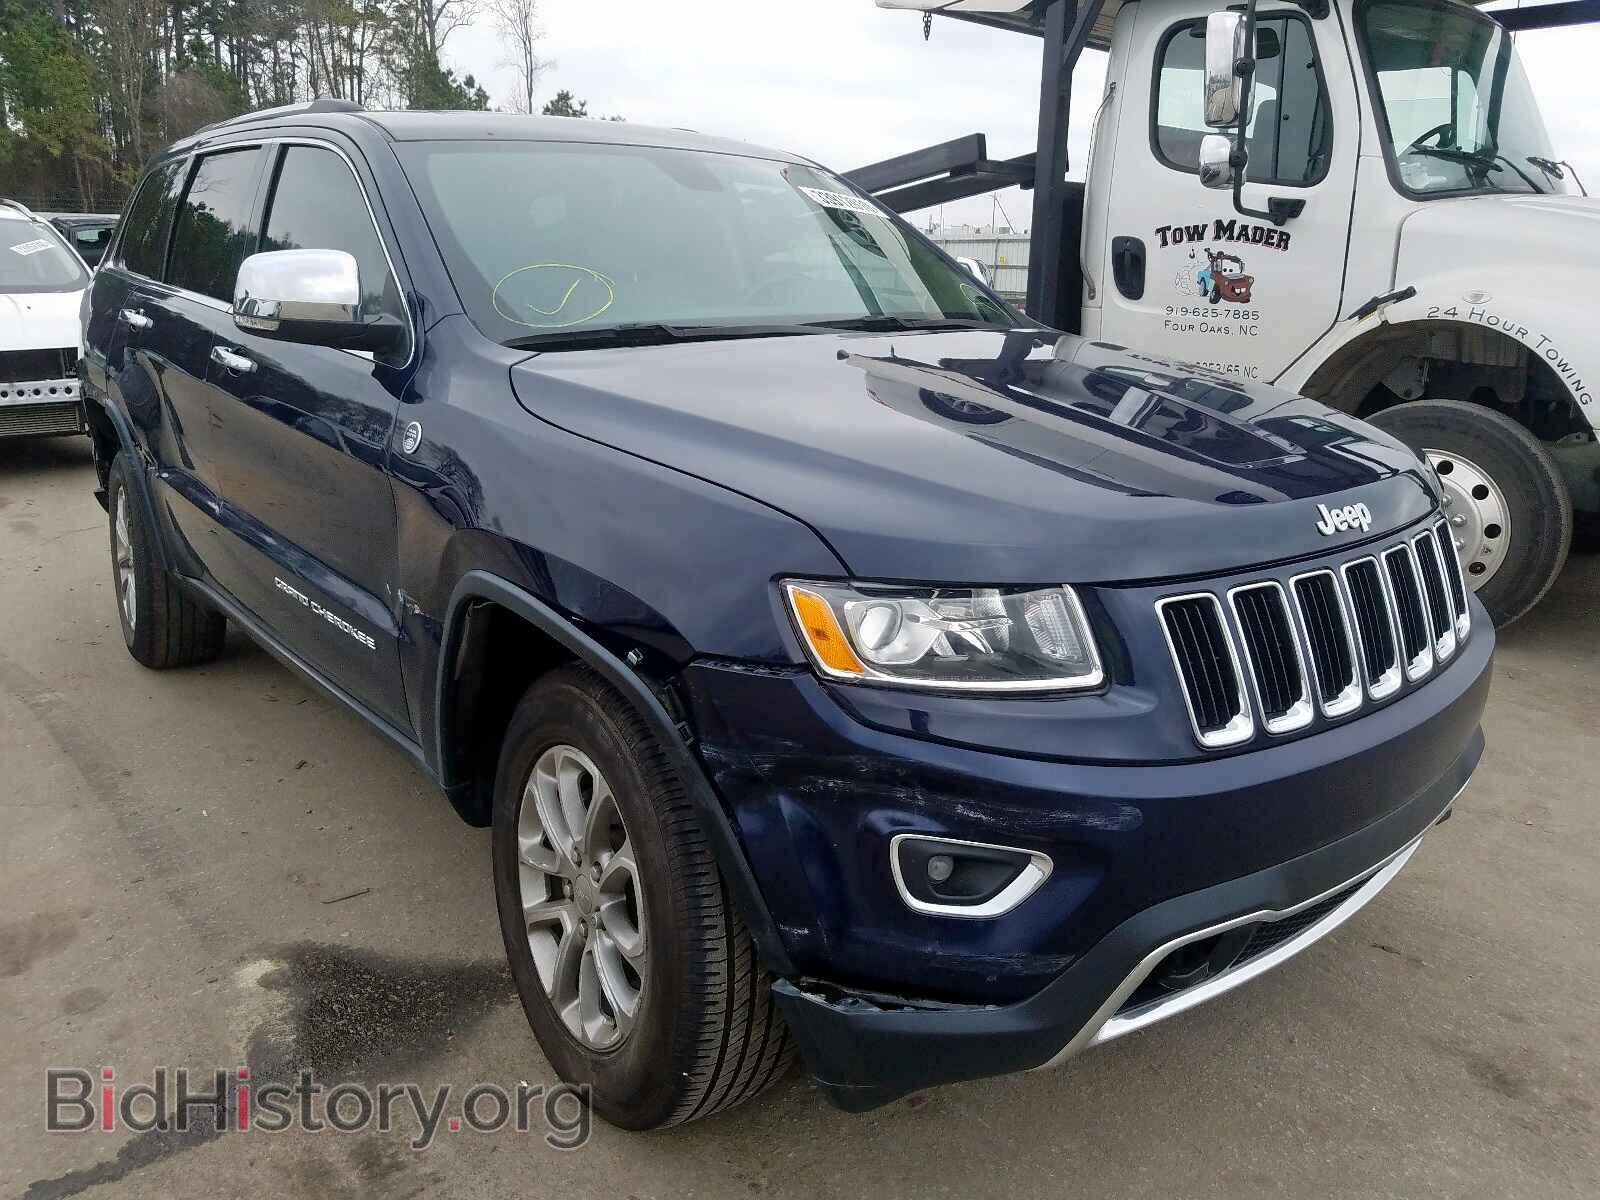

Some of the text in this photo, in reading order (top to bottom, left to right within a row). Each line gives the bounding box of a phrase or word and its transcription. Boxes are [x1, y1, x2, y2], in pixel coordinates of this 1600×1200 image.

[1155, 219, 1291, 251] TOW MADER
[1164, 319, 1258, 337] FOUR OAKS, NC
[1165, 305, 1260, 321] 919-625-7885
[1243, 365, 1258, 379] NC
[1426, 306, 1593, 406] 24 HOUR TOWING
[1316, 502, 1372, 536] Jeep
[310, 600, 376, 650] CHEROKEE
